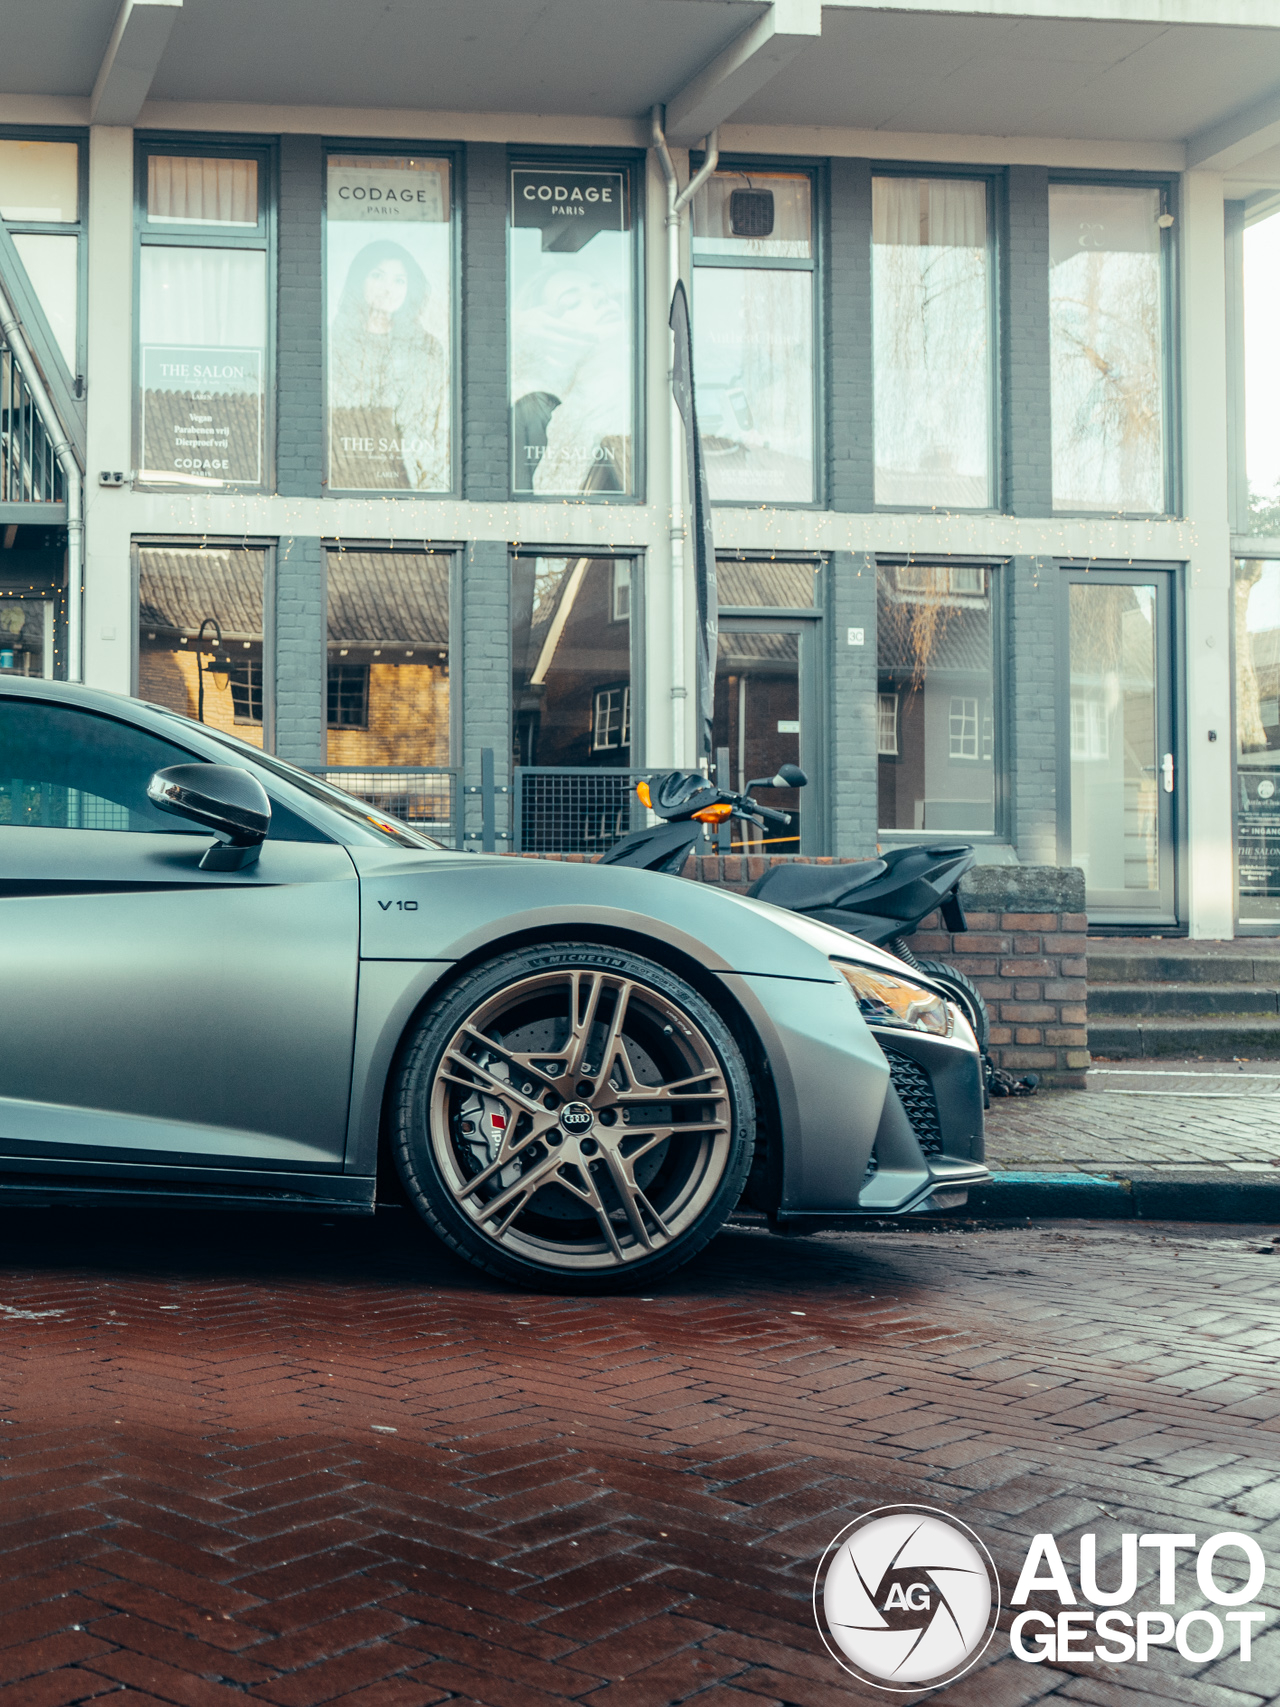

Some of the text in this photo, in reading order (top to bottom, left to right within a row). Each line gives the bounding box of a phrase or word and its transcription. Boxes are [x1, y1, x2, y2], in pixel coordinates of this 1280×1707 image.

[338, 186, 427, 203] CODAGE
[523, 185, 613, 203] CODAGE
[367, 206, 400, 215] PARIS
[551, 205, 585, 216] PARIS
[160, 363, 245, 379] THE SALON
[189, 413, 213, 424] Vegan
[174, 425, 230, 436] Parabenen vrij
[175, 438, 228, 449] Dierproef vrij
[340, 437, 436, 454] THE SALON
[523, 445, 616, 461] THE SALON
[174, 458, 229, 470] CODAGE
[849, 631, 864, 642] 3C
[377, 900, 419, 911] V10
[549, 953, 623, 967] MICHELIN
[631, 963, 651, 977] PILOT
